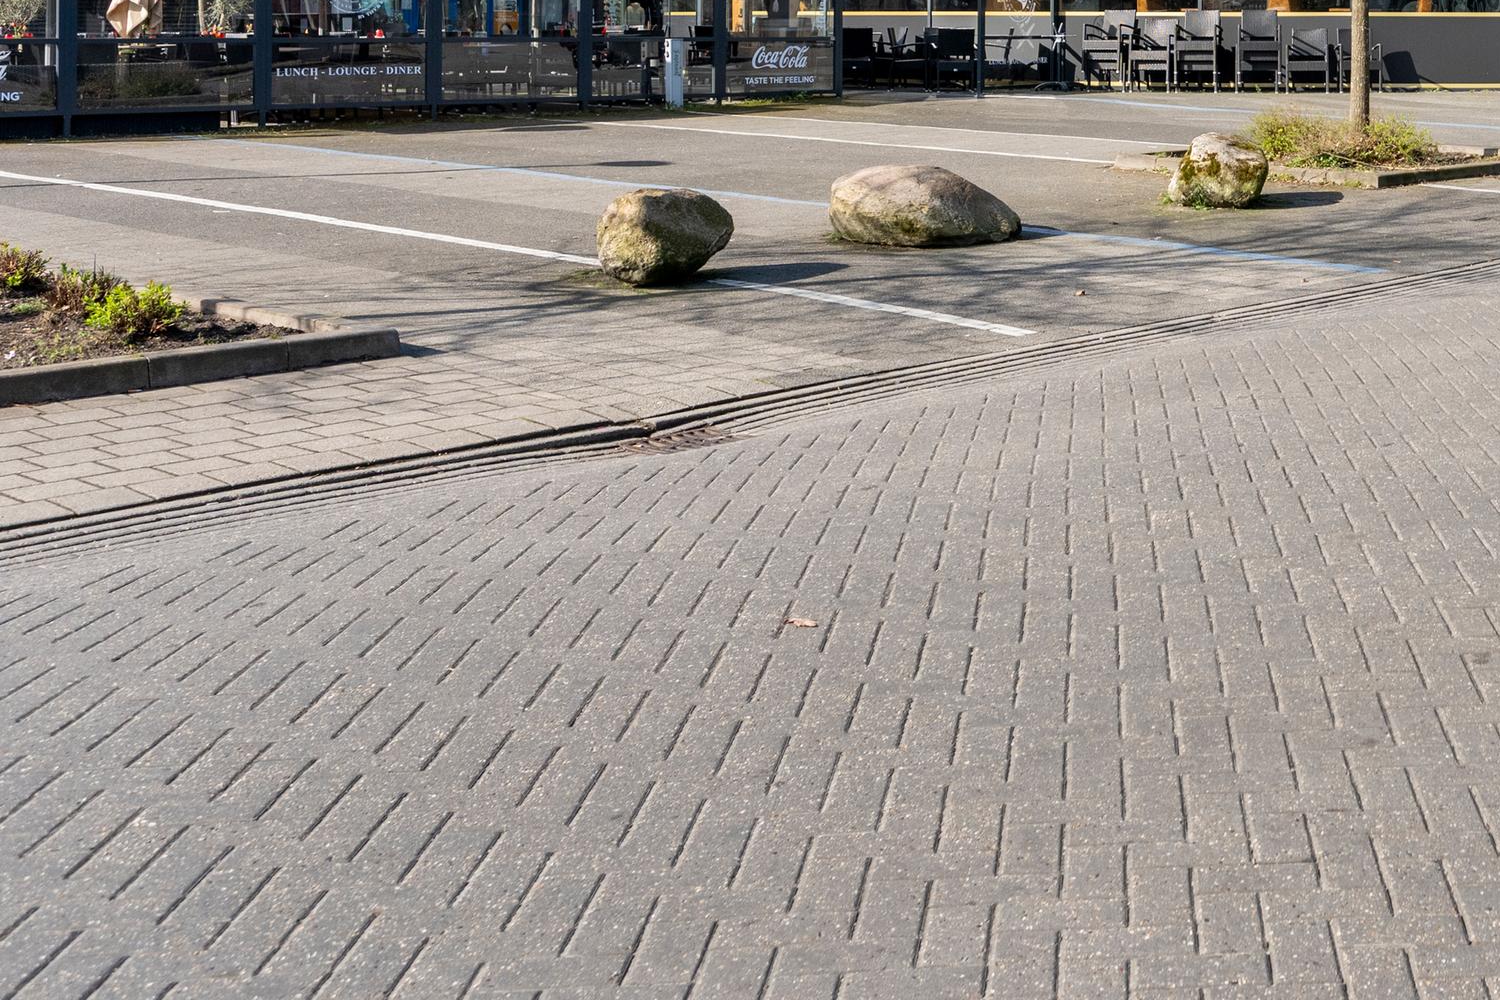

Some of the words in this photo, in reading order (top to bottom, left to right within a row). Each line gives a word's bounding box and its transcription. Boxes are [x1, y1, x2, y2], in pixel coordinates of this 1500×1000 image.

[276, 67, 318, 77] LUNCH
[328, 66, 377, 76] LOUNGE
[386, 66, 422, 75] DINER
[745, 76, 768, 85] TASTE
[769, 76, 784, 84] THE
[784, 75, 815, 84] FEELING
